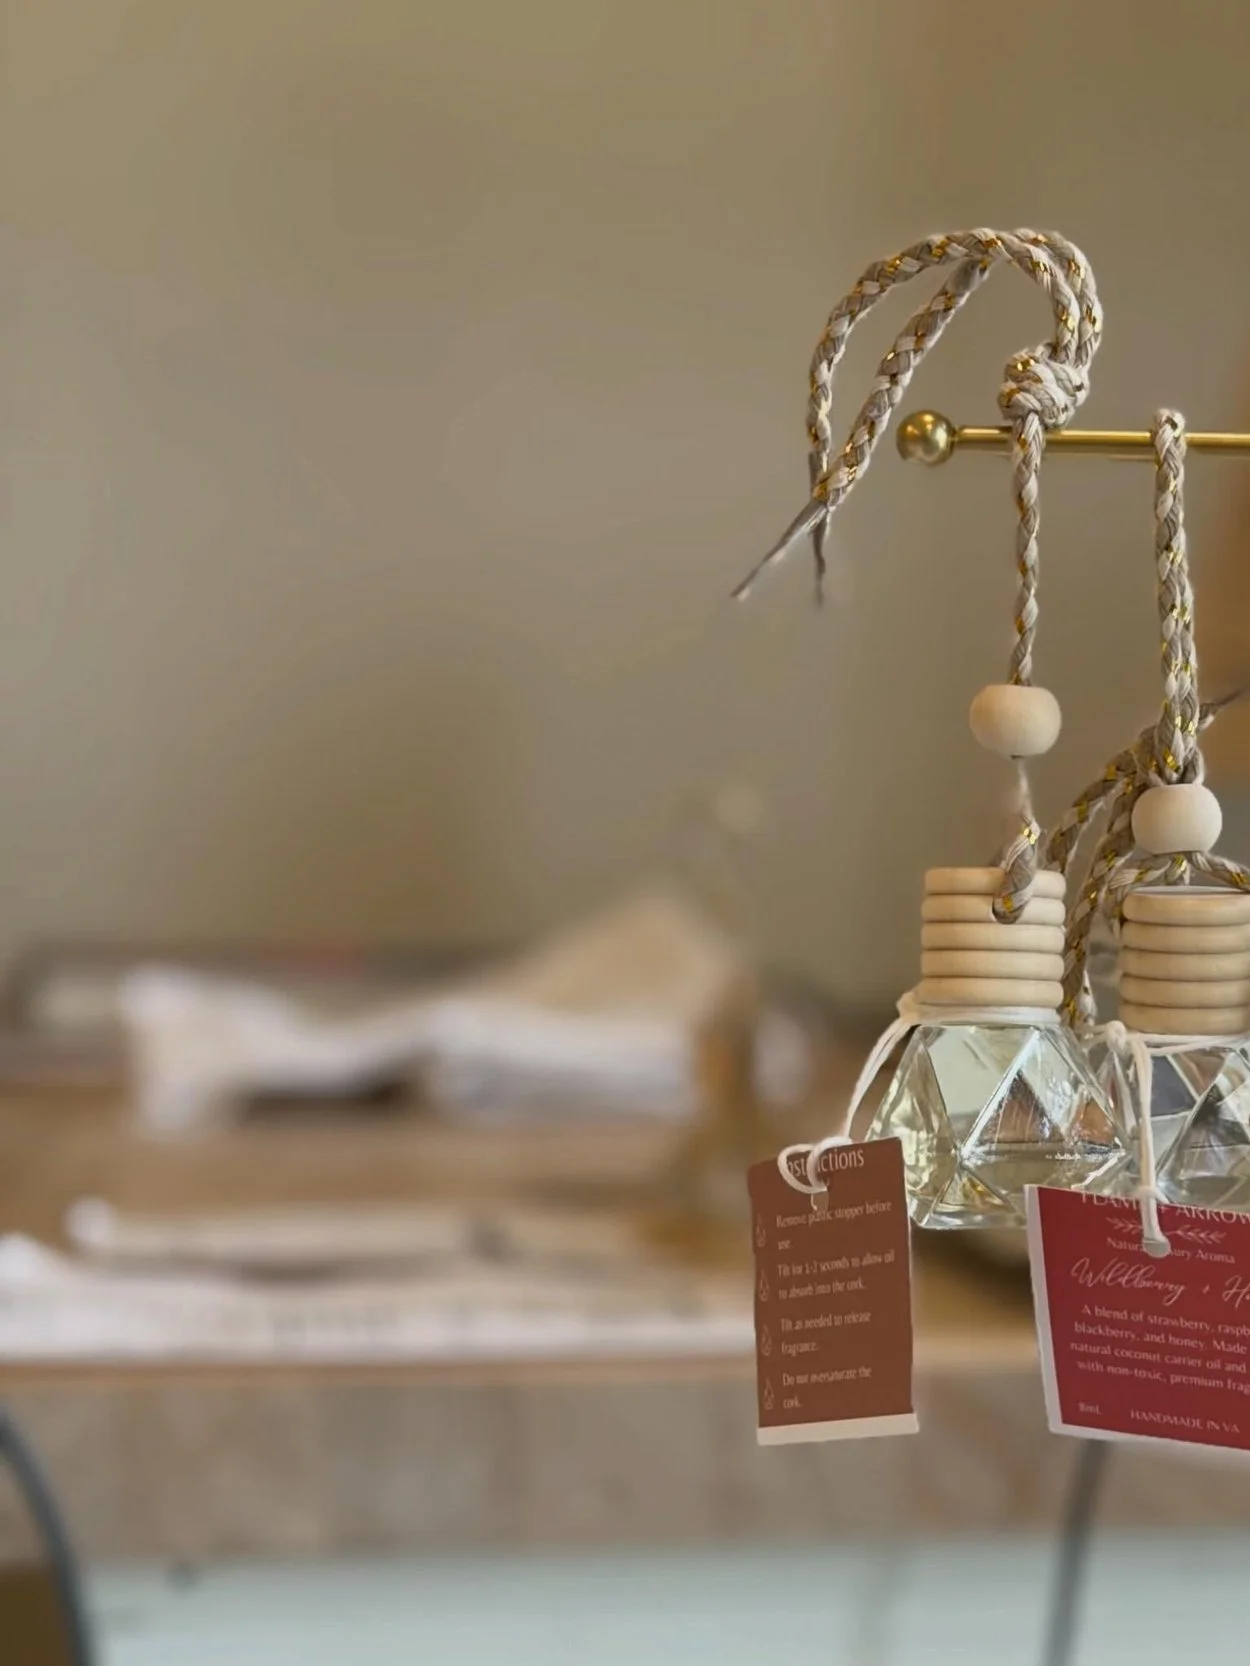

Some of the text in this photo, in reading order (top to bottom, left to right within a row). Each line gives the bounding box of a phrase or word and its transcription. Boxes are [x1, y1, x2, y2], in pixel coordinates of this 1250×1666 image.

[1106, 1237, 1235, 1264] Natura Aroma
[1082, 1305, 1092, 1316] A
[1095, 1305, 1128, 1321] blend
[1131, 1311, 1144, 1323] of
[1148, 1312, 1214, 1333] strawberry,
[1074, 1321, 1140, 1343] blackberry,
[1143, 1331, 1165, 1344] and
[1213, 1339, 1248, 1355] Made
[1070, 1342, 1111, 1356] natural
[1114, 1349, 1162, 1364] coconut
[1165, 1354, 1203, 1368] carrier
[1206, 1358, 1221, 1370] oil
[1225, 1360, 1246, 1374] and
[1077, 1360, 1103, 1373] with
[1170, 1374, 1223, 1388] premium
[1131, 1409, 1202, 1429] HANDMADE
[1207, 1420, 1219, 1432] IN
[1222, 1422, 1240, 1434] VA
